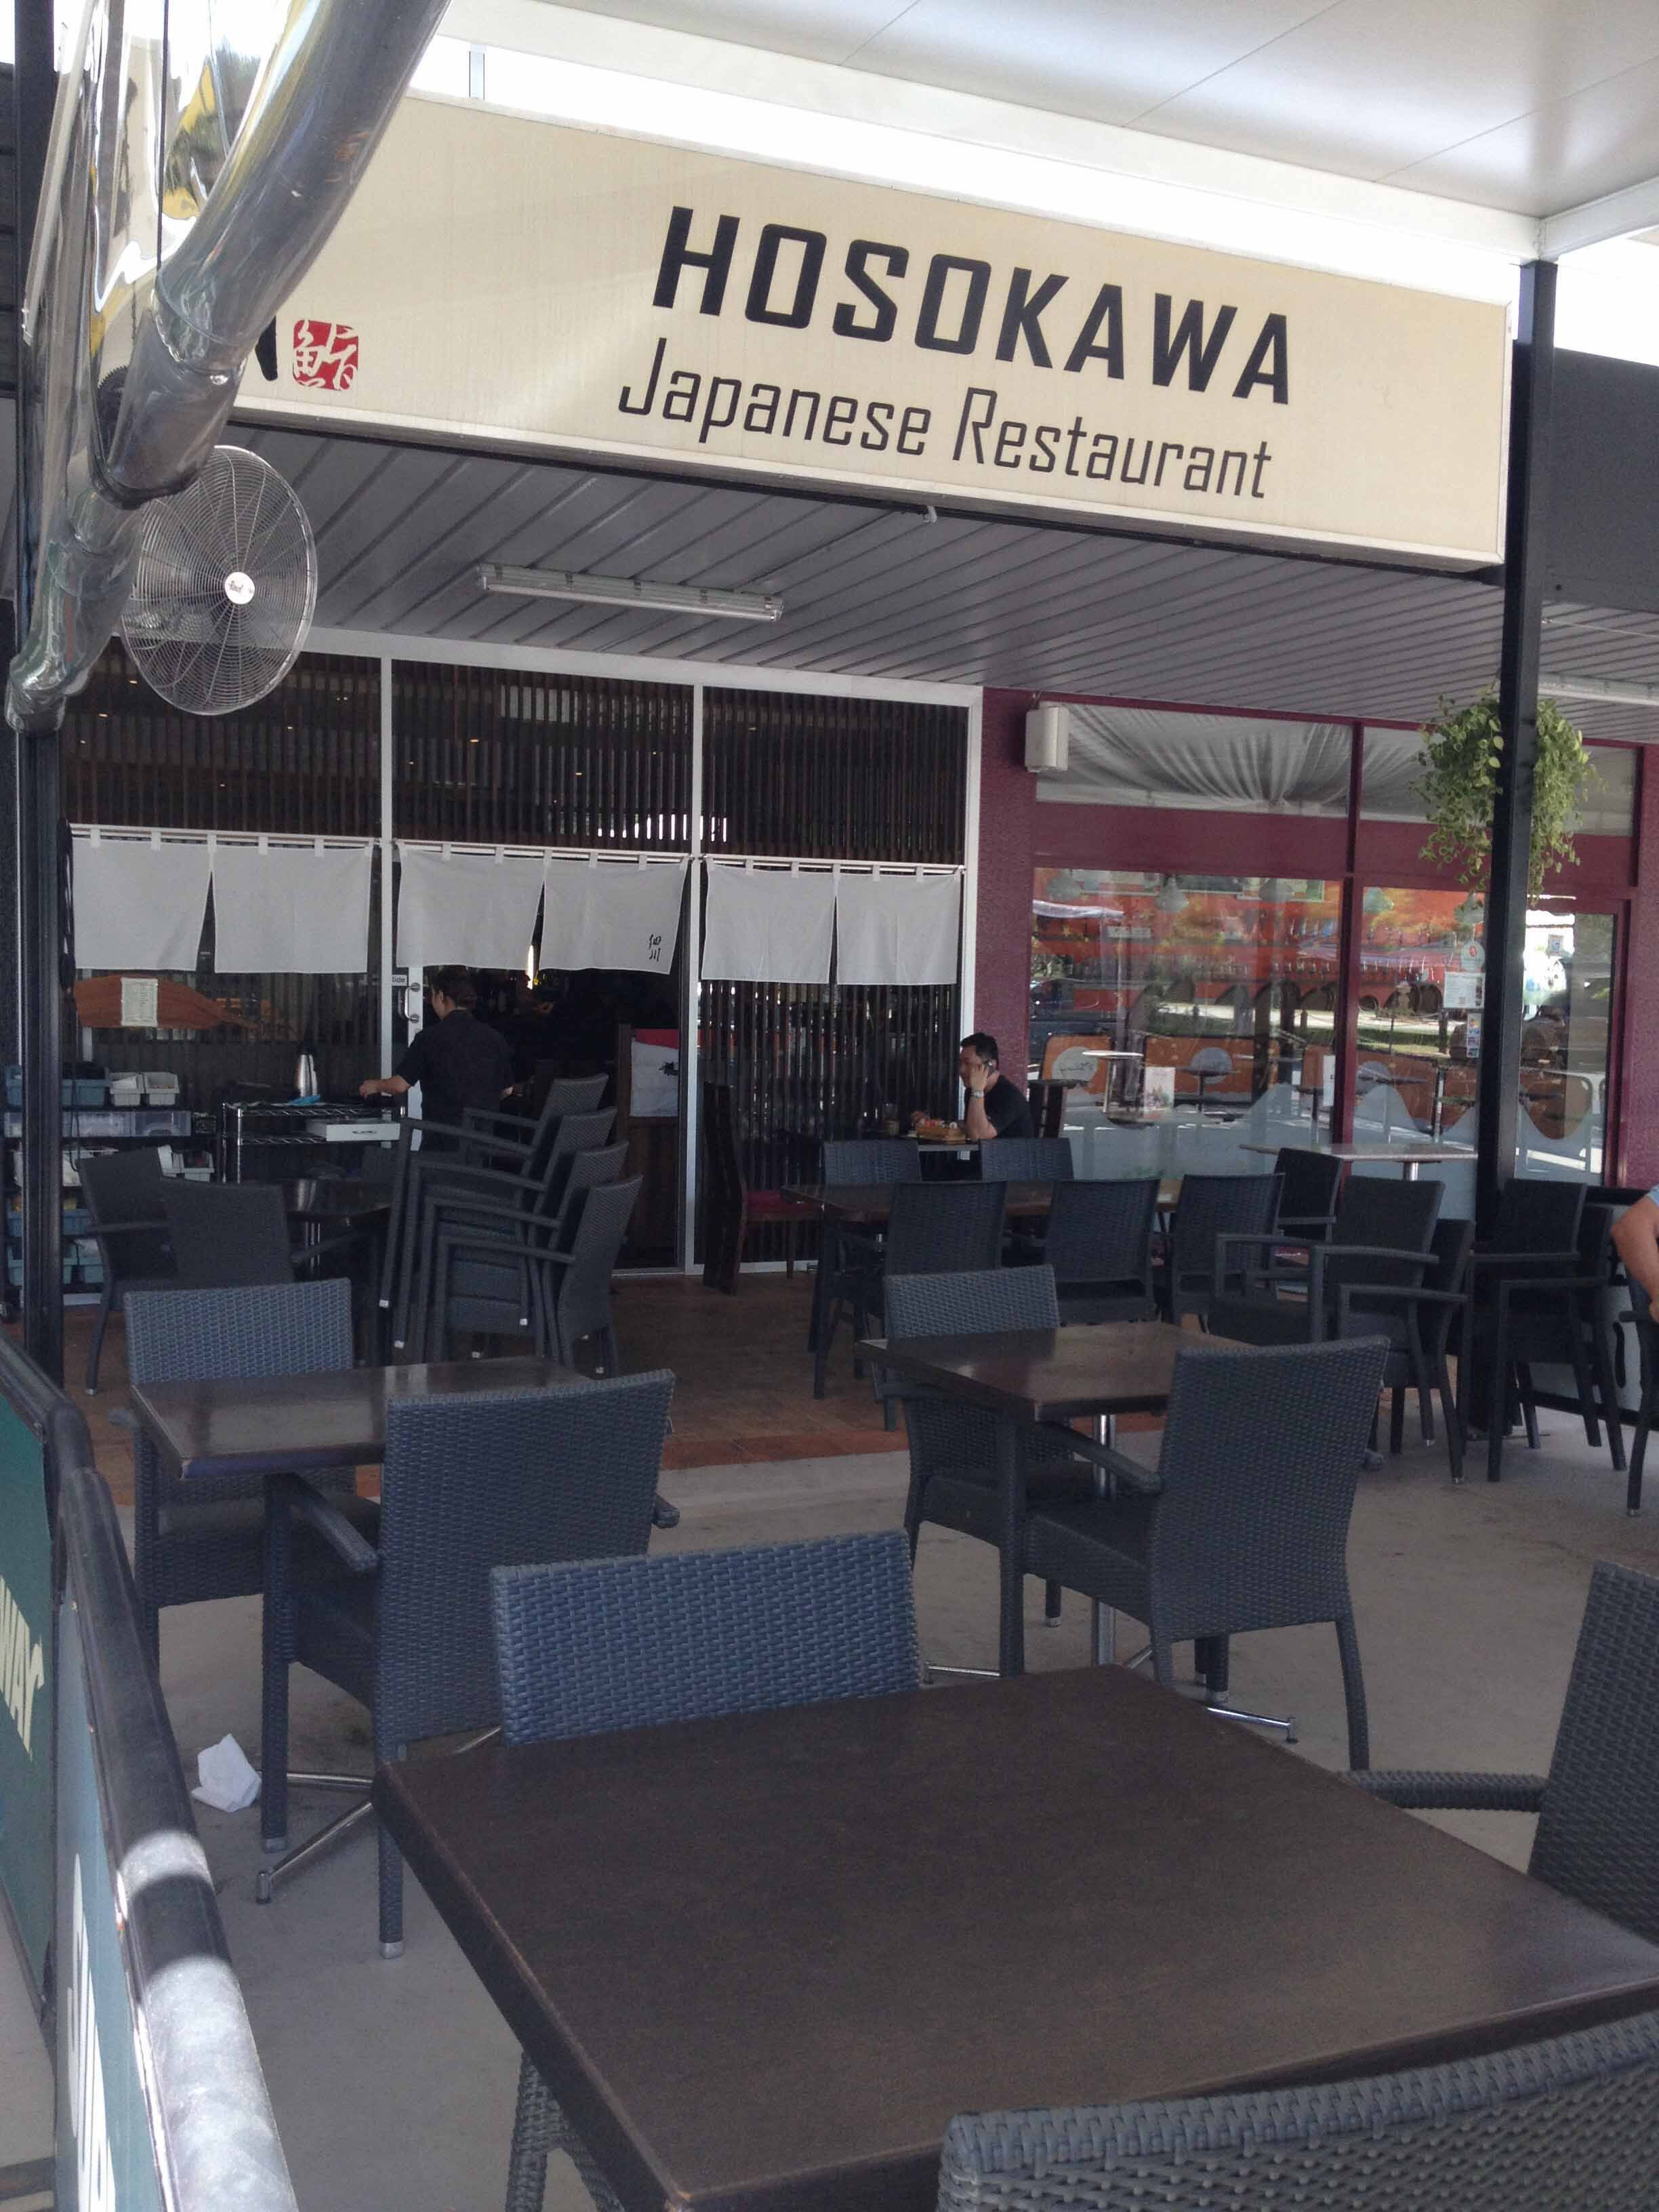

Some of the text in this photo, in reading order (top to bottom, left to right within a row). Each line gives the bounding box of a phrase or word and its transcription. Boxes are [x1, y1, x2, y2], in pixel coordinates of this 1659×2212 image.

[653, 205, 1288, 405] HOSOKAWA
[618, 337, 1271, 498] Japanese Restaurant
